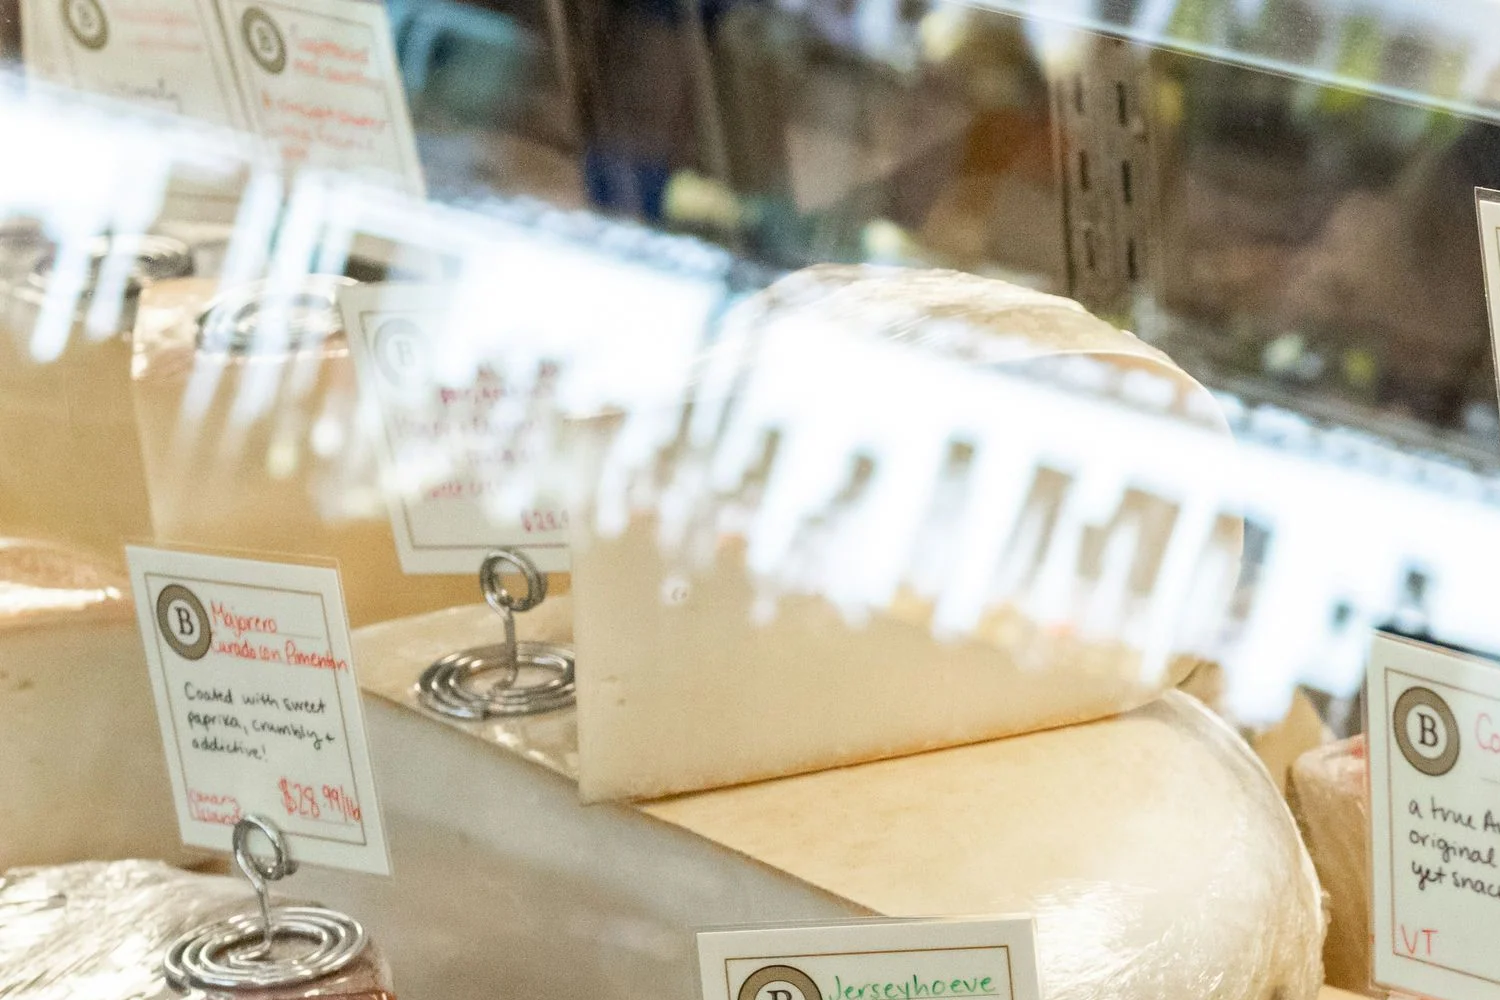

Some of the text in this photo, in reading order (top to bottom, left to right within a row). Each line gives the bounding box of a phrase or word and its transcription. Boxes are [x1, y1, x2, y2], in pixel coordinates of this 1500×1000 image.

[174, 606, 194, 636] B
[184, 681, 234, 704] Coated
[243, 692, 280, 710] with
[187, 710, 249, 735] paprika,
[251, 719, 323, 751] crumbly
[1416, 711, 1439, 747] B
[192, 736, 269, 763] addictive!
[1408, 799, 1423, 819] a
[1430, 797, 1477, 831] true
[1411, 860, 1447, 891] yet
[1401, 924, 1439, 956] VT
